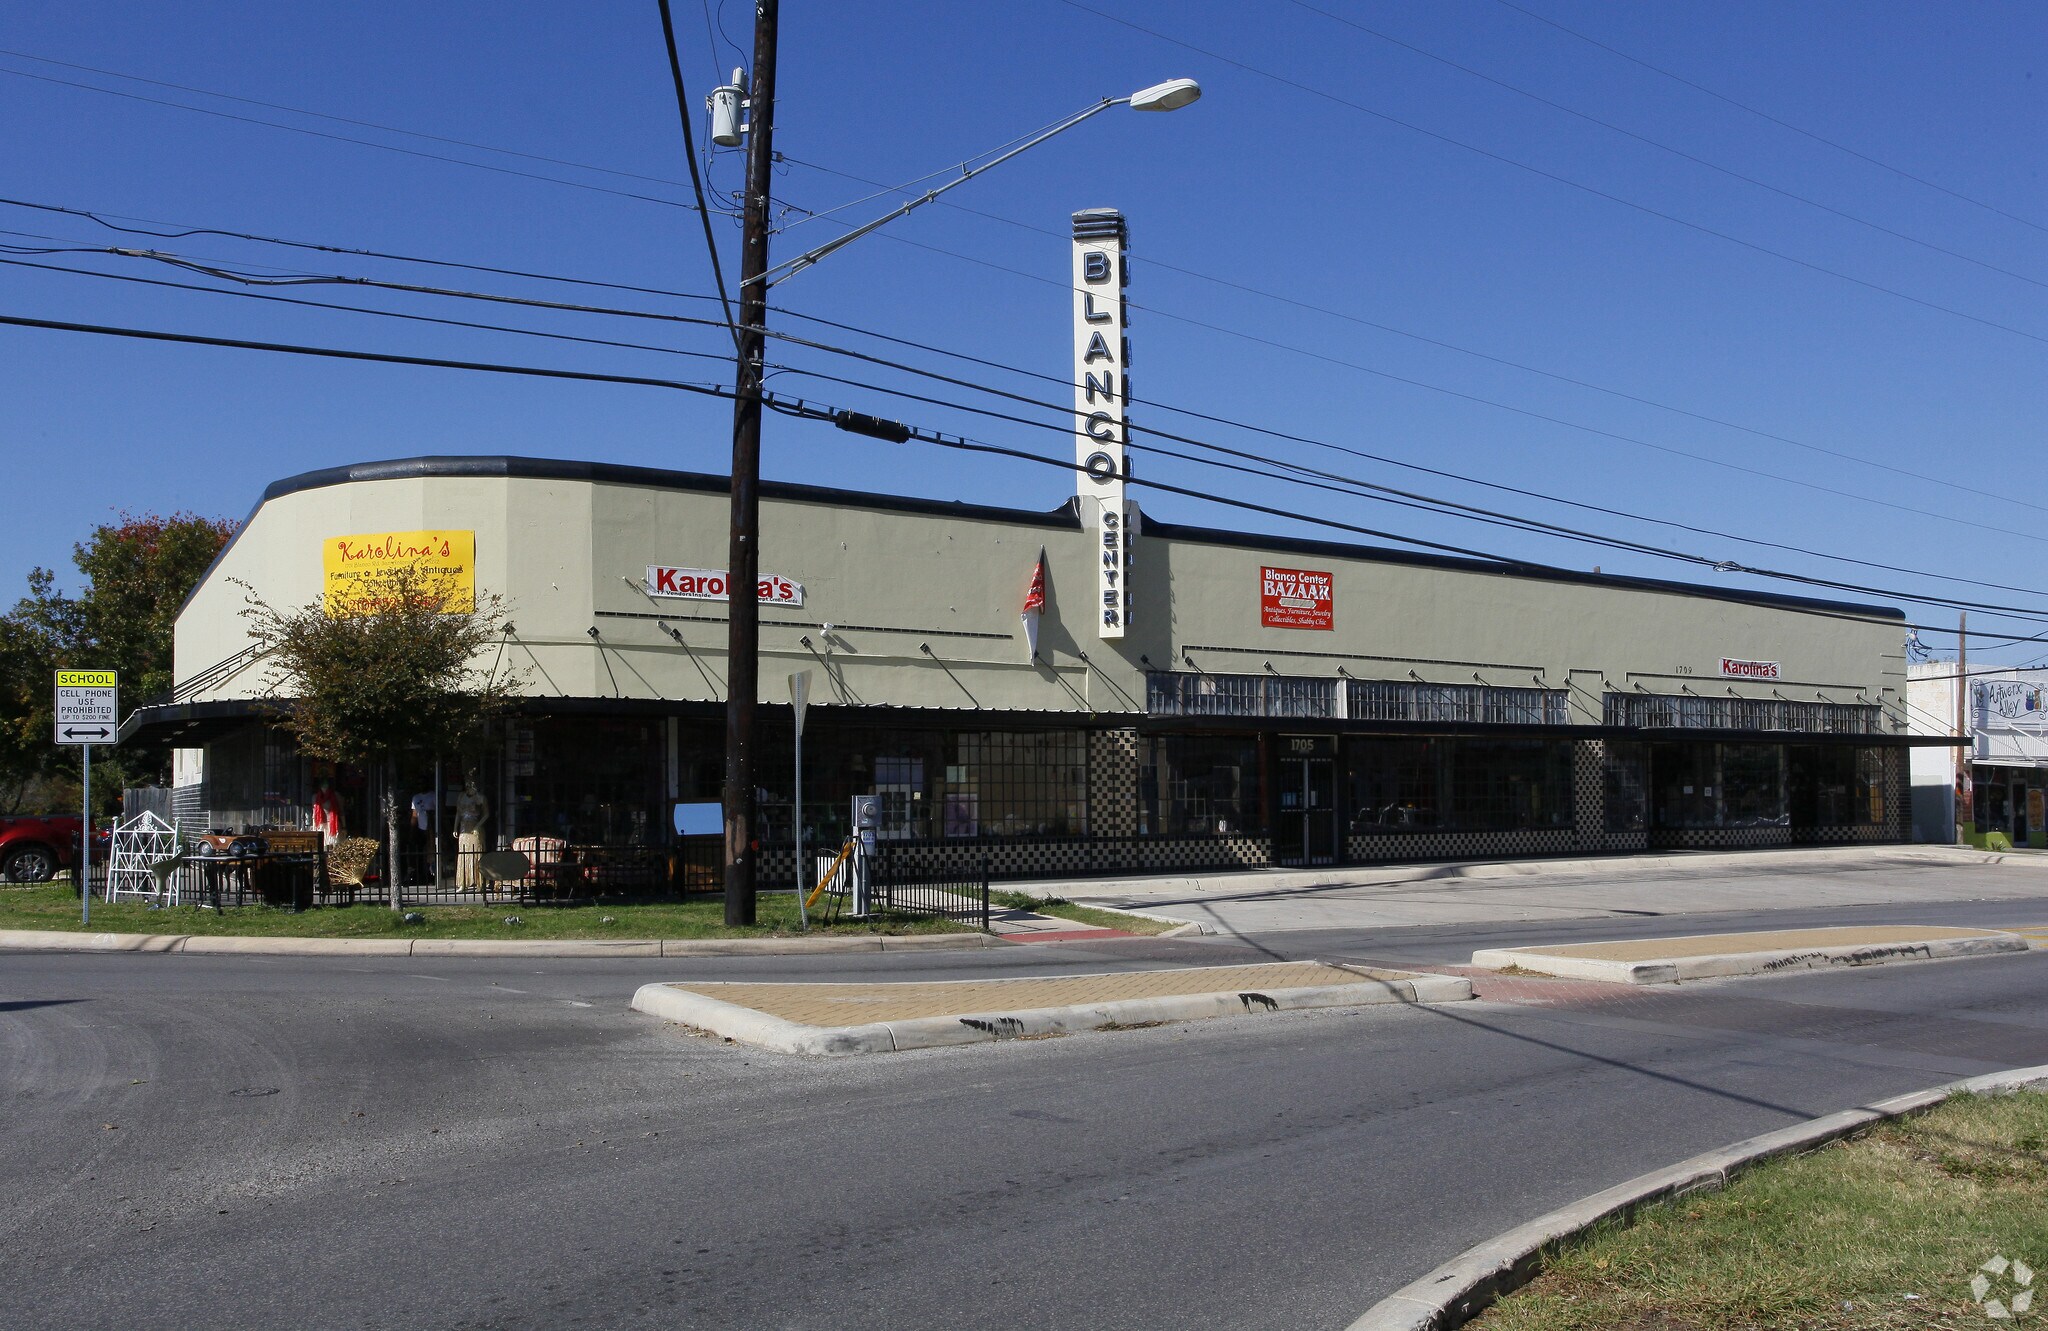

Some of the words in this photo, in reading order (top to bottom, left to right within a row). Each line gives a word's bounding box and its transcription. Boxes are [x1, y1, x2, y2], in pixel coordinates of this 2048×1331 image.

[1083, 251, 1116, 482] BLANCO
[338, 535, 450, 562] Karolina's
[1102, 510, 1120, 628] CENTER
[1265, 569, 1296, 582] Blanco
[1298, 572, 1328, 585] Center
[656, 568, 793, 599] Karola's
[1264, 580, 1330, 600] BAZAAR
[1297, 617, 1315, 627] Shabby
[1315, 618, 1327, 626] Chic
[1675, 665, 1693, 674] 1709
[1722, 658, 1777, 677] Karolina's
[60, 674, 113, 684] SCHOOL
[61, 706, 112, 714] PROHIBITED
[78, 698, 95, 706] USE
[1291, 738, 1314, 751] 1705
